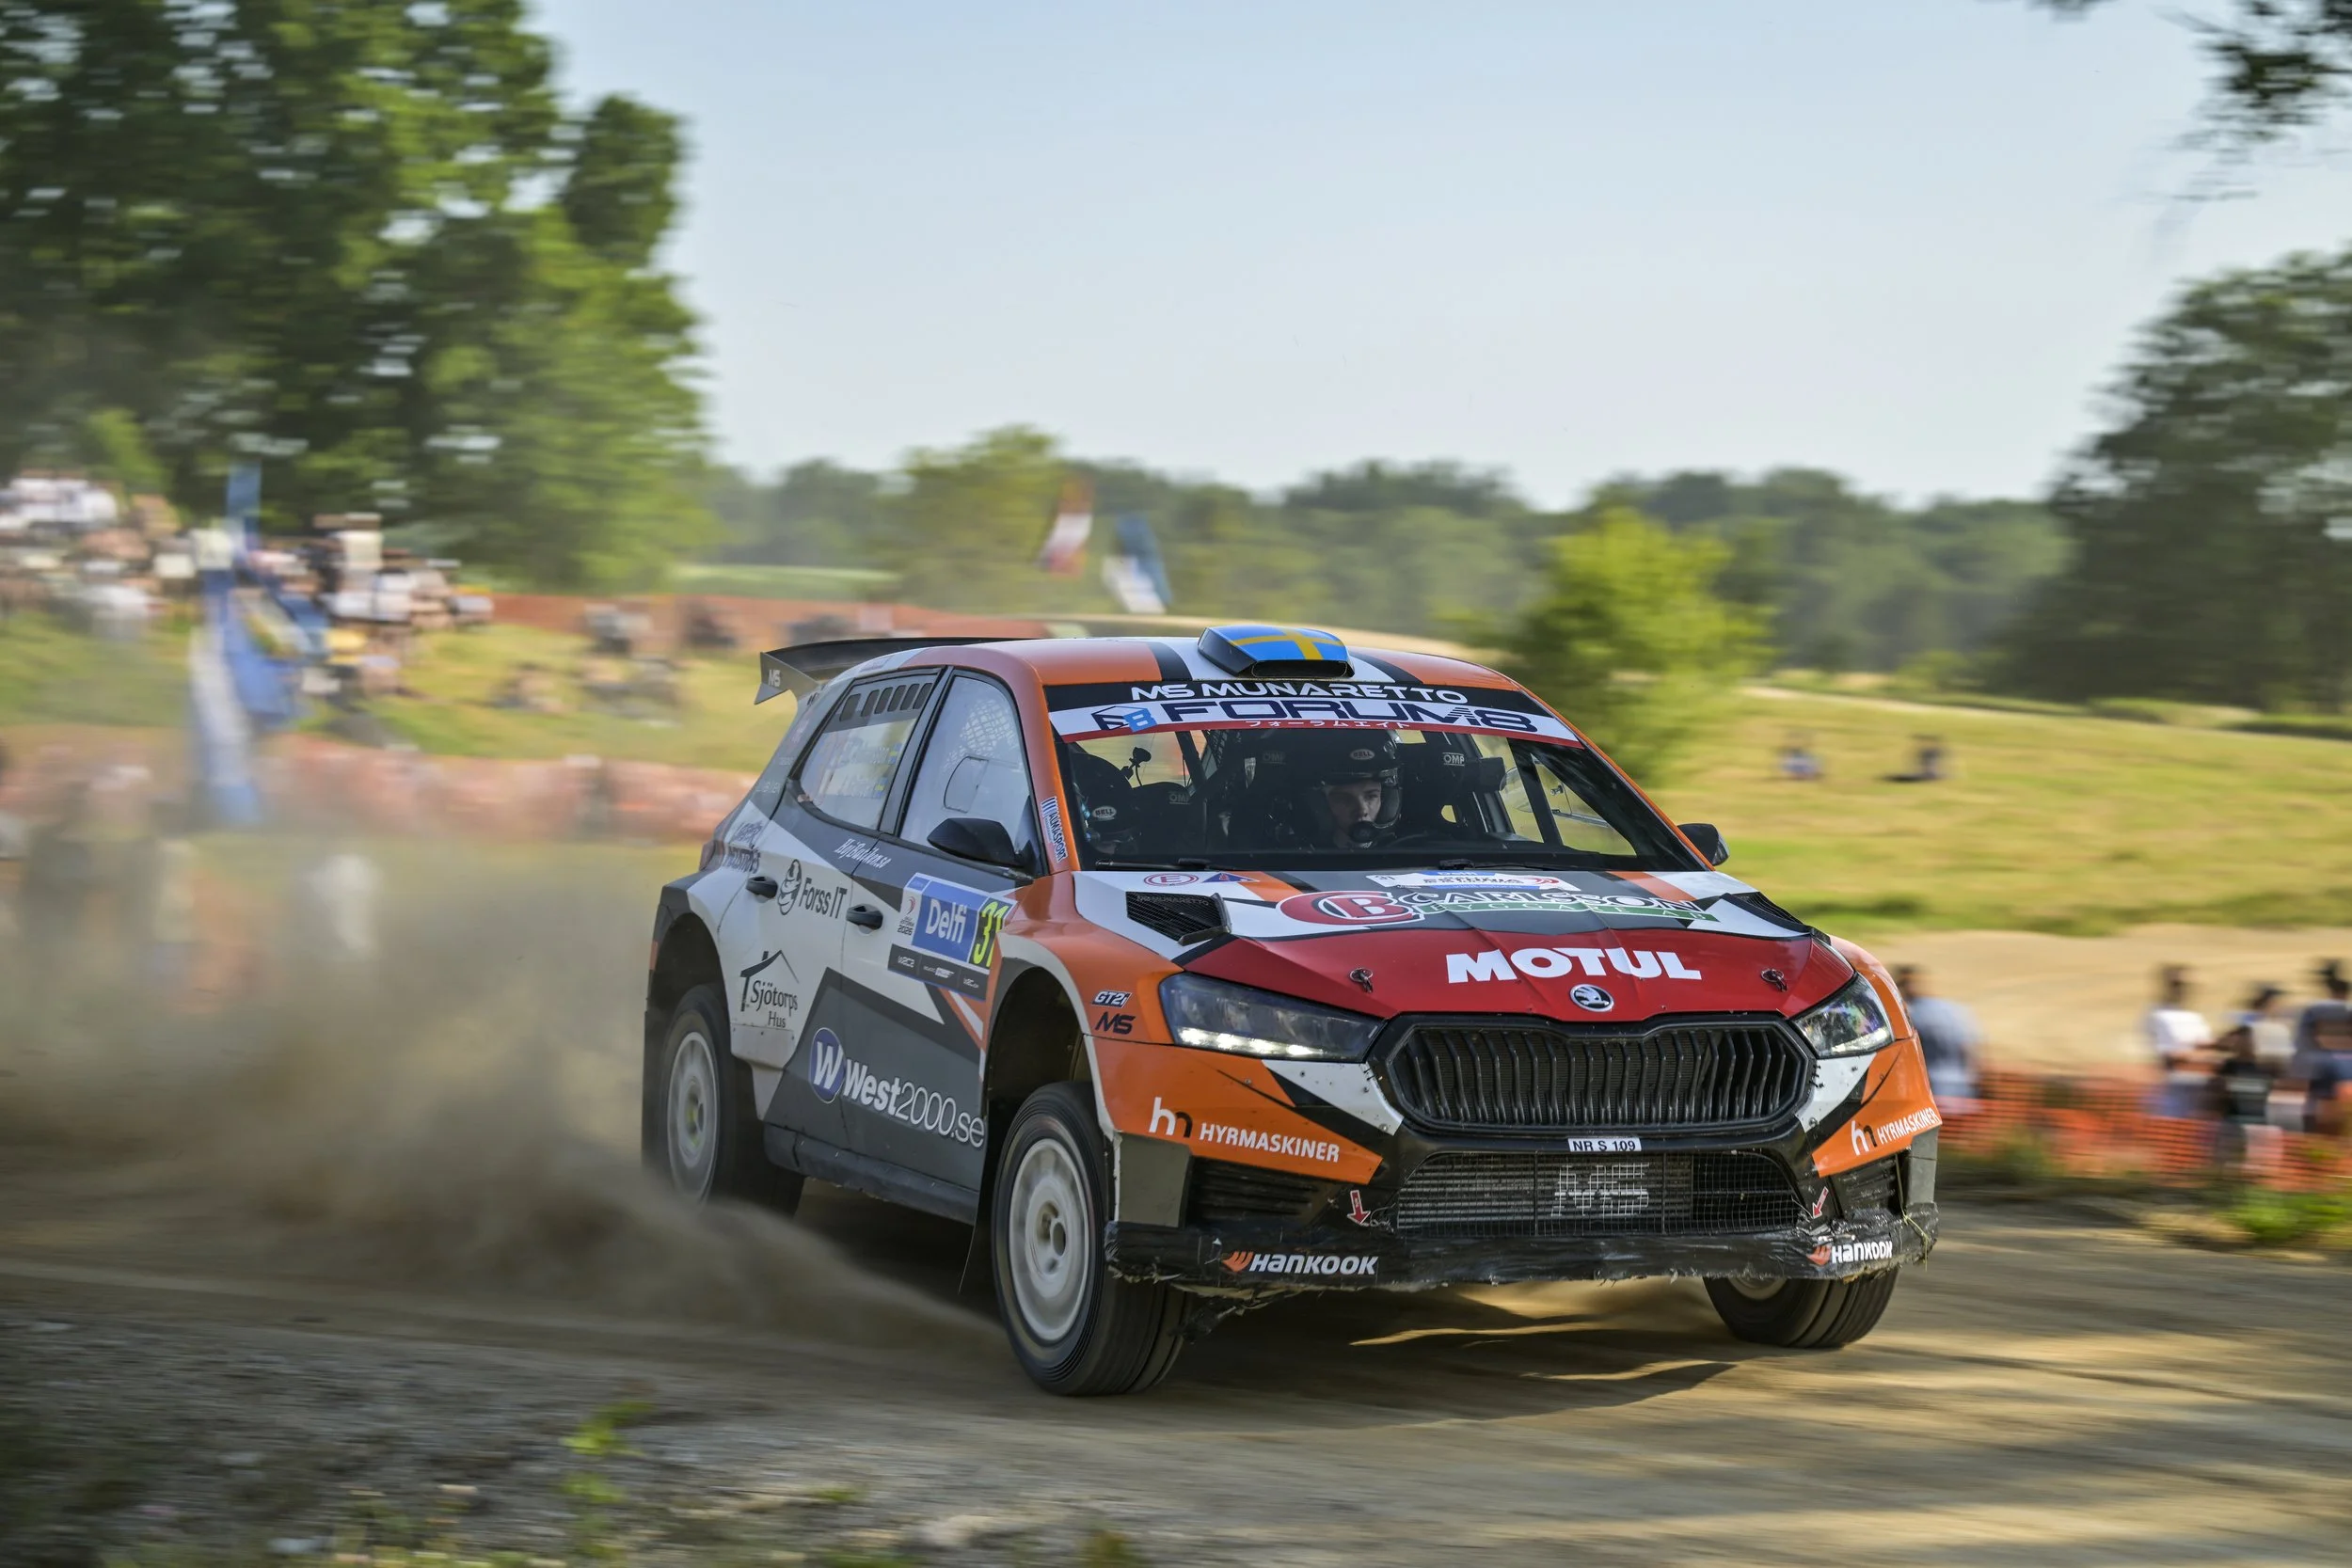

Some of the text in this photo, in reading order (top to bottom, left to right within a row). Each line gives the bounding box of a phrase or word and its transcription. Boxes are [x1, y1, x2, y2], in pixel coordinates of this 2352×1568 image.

[1131, 682, 1469, 704] MS MUNARETTO
[1160, 699, 1538, 733] FORUM8
[1245, 720, 1410, 729] フォーラムエイト
[1443, 753, 1465, 764] OMP
[1048, 812, 1067, 863] ALMASPORT
[798, 877, 849, 919] Forss IT
[1397, 890, 1708, 913] CARLSSON
[925, 898, 968, 943] Delfi
[973, 901, 1009, 968] 31
[1446, 946, 1703, 984] MOTUL
[750, 980, 799, 1018] Sjötorps
[768, 1010, 787, 1028] Hus
[1094, 1011, 1136, 1035] MS
[842, 1058, 985, 1148] West2000.se
[1199, 1122, 1341, 1163] HYRMASKINER
[1877, 1107, 1942, 1145] HYRMASKINER
[1572, 1141, 1636, 1151] NR S 109
